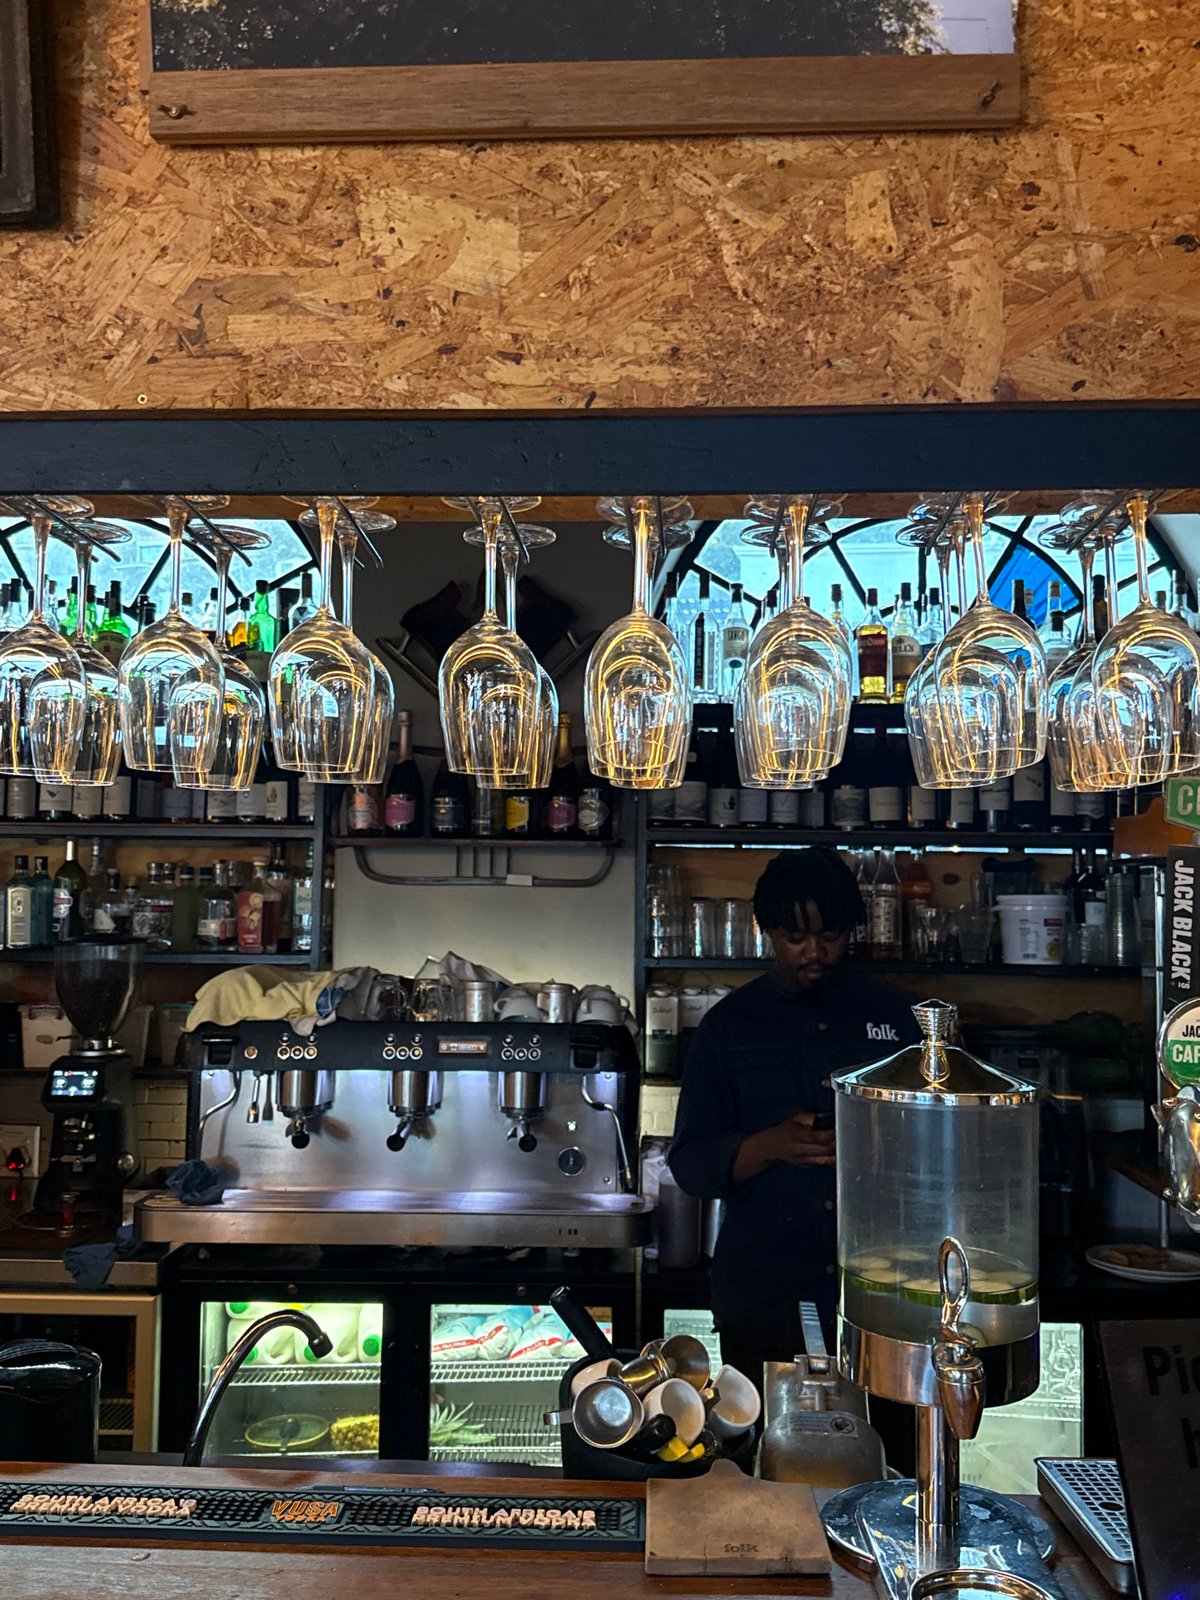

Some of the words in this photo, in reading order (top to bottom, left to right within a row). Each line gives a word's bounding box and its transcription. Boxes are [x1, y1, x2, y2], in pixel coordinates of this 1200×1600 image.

[1173, 860, 1195, 913] JACK
[866, 1022, 900, 1041] folk
[117, 1503, 193, 1518] VODKA
[271, 1500, 339, 1518] VUSA
[724, 1543, 760, 1553] folk
